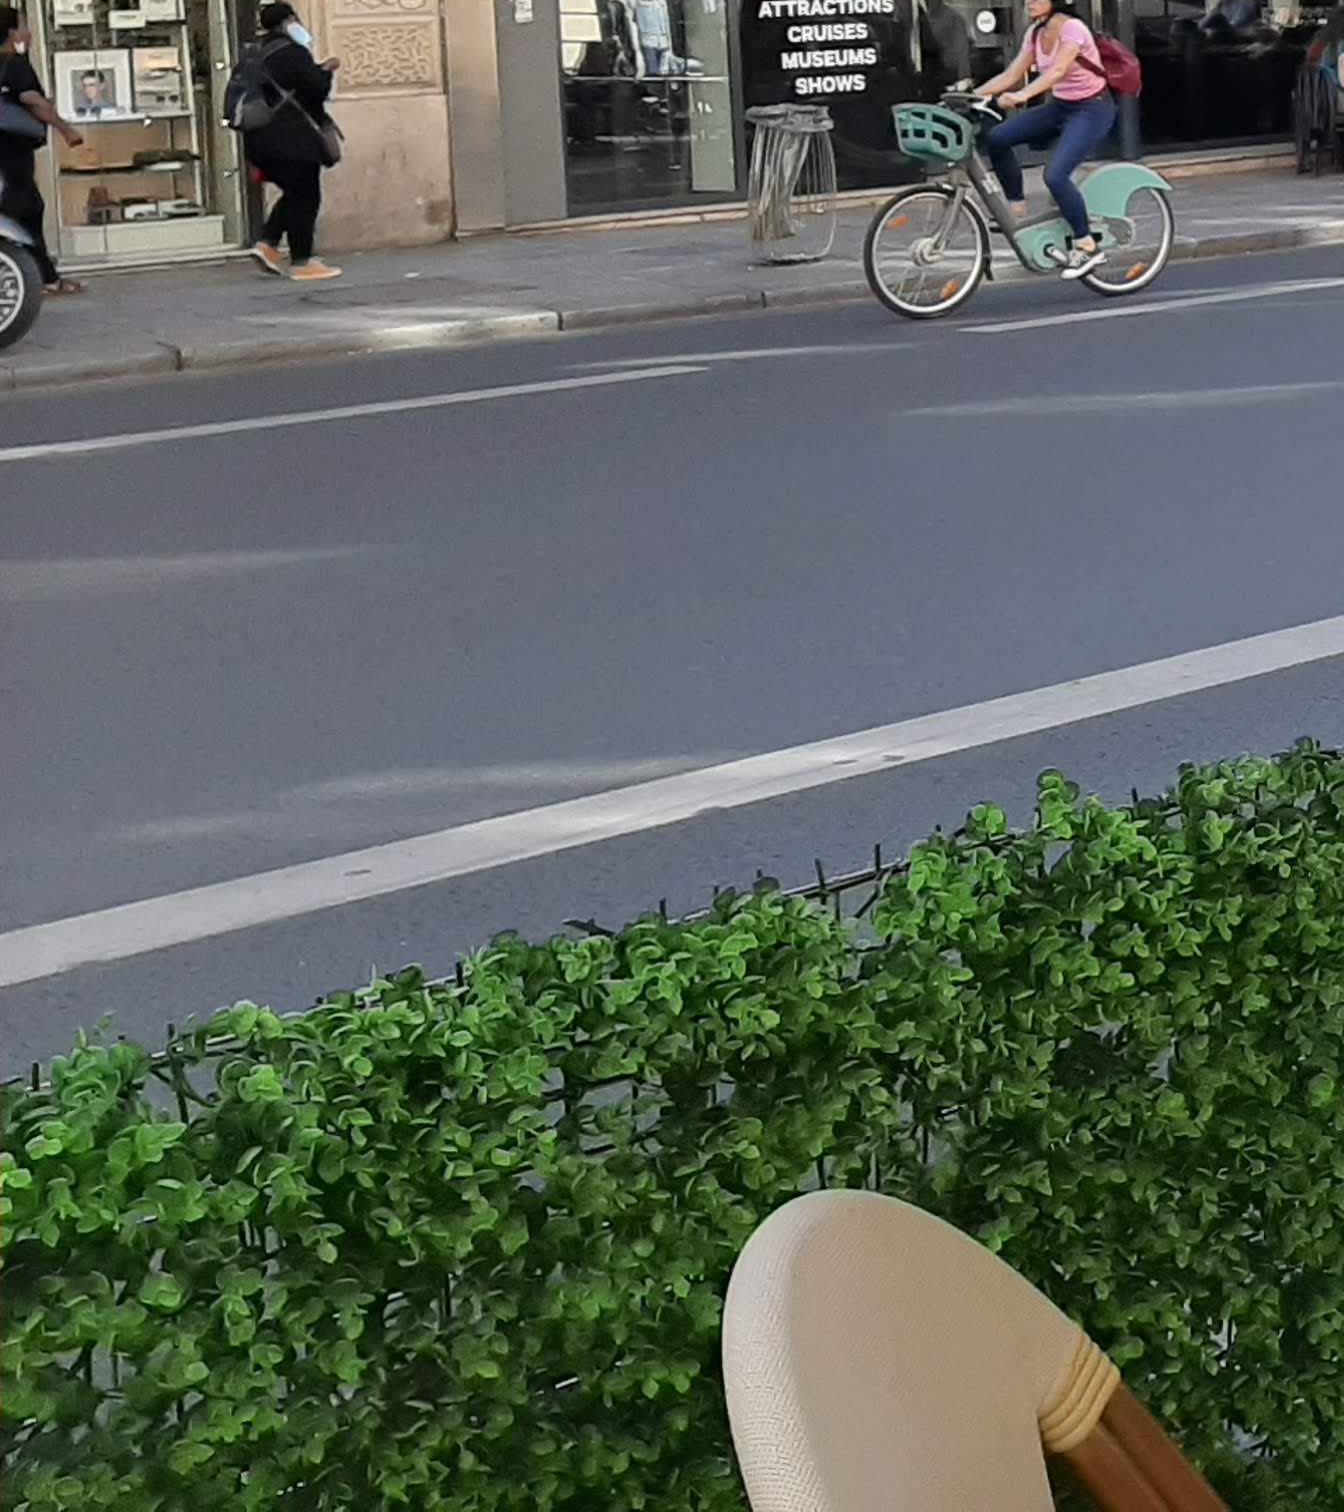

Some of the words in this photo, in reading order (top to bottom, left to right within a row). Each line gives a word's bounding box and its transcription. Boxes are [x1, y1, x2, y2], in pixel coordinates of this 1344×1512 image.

[786, 22, 868, 42] CRUISES
[780, 48, 877, 69] MUSEUMS
[794, 74, 867, 95] SHOWS
